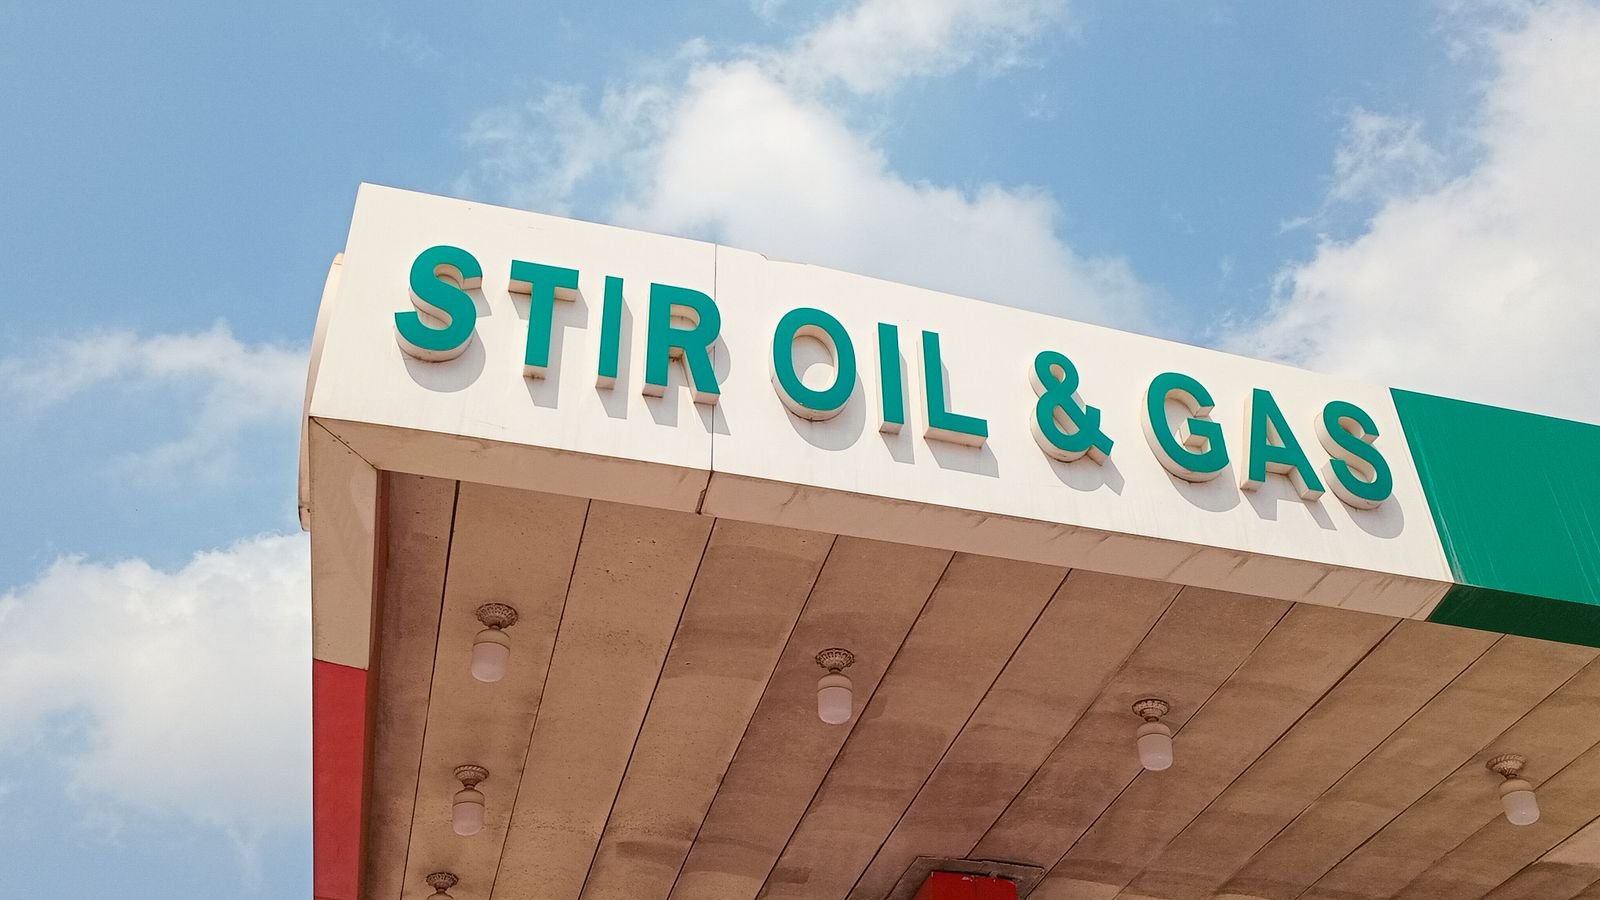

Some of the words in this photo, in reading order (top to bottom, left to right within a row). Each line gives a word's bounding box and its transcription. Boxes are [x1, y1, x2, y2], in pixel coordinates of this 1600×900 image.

[394, 245, 721, 397] STIR
[772, 307, 989, 438] OIL
[1034, 351, 1114, 457] &
[1146, 372, 1393, 501] GAS
